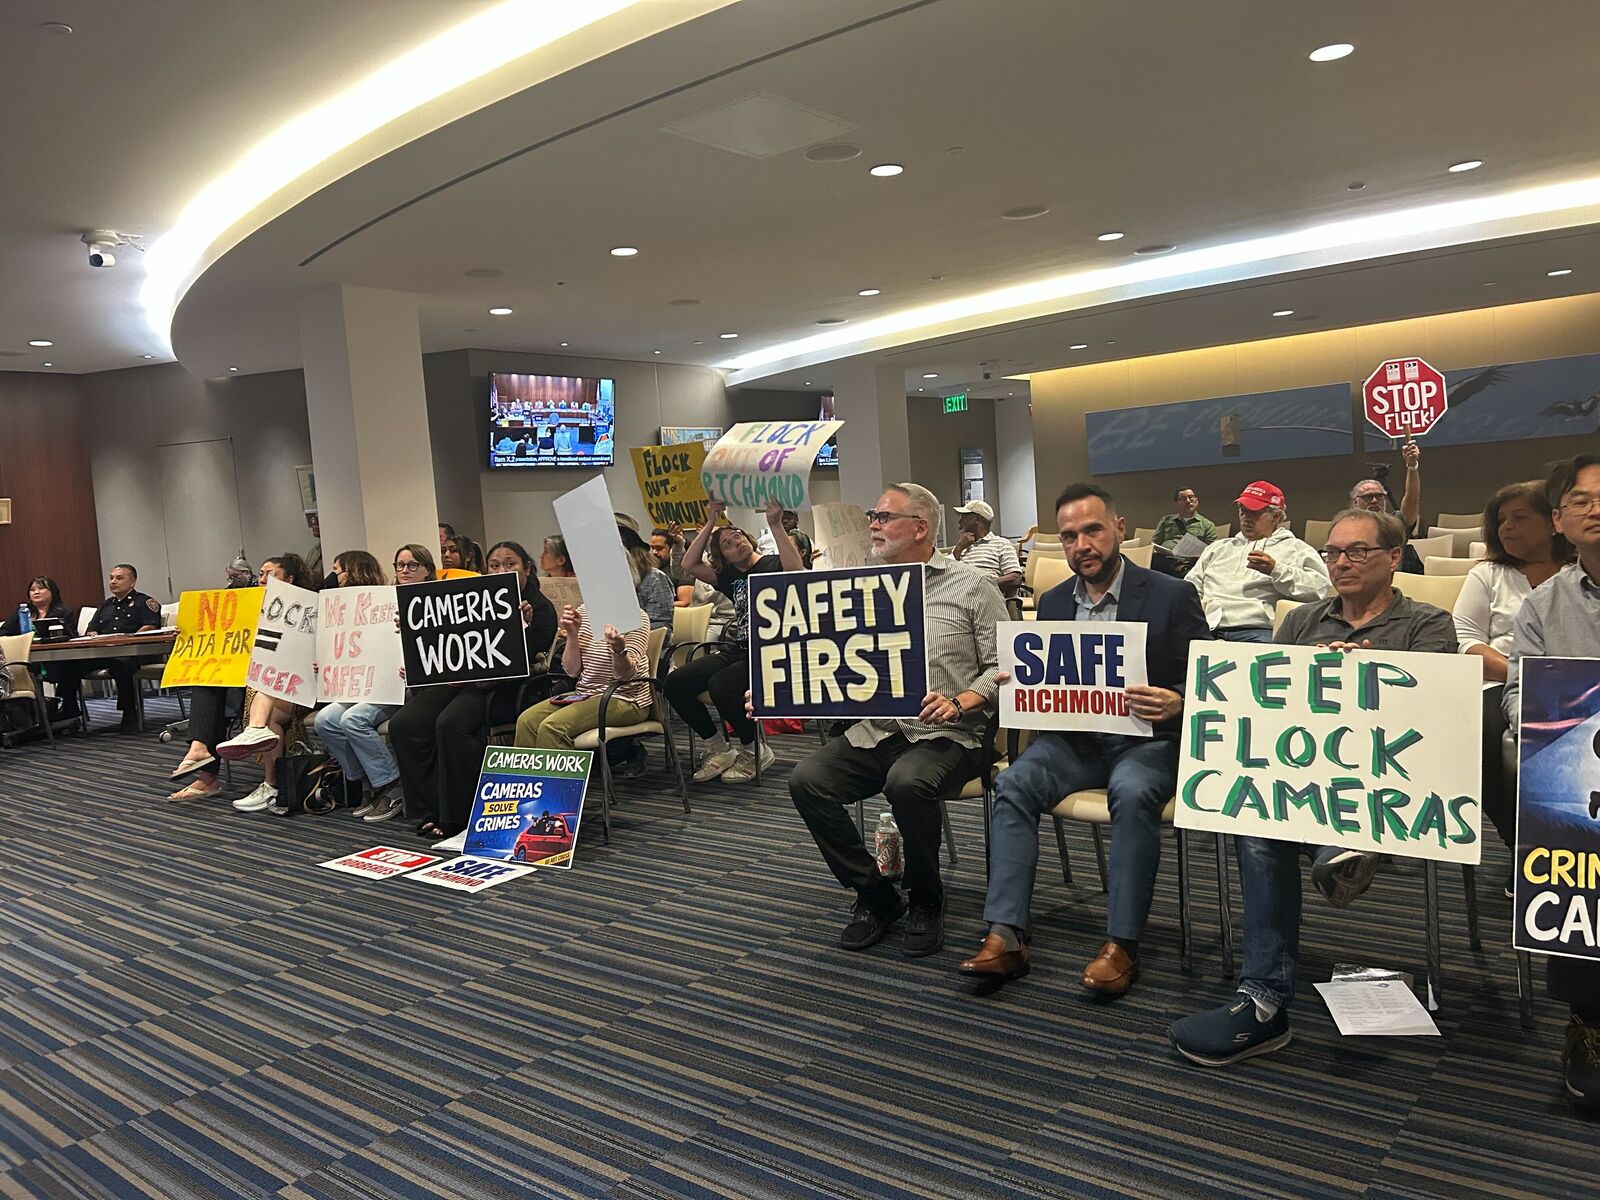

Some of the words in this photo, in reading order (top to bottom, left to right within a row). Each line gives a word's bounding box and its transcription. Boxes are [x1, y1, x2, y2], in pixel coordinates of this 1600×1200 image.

[946, 396, 964, 412] EXIT
[1372, 381, 1437, 414] STOP
[1384, 406, 1434, 430] FLOCK!
[740, 424, 825, 445] FLOCK
[643, 449, 692, 478] FLOCK
[711, 448, 756, 471] OUT
[759, 447, 797, 472] OF
[644, 479, 670, 498] OUT
[198, 591, 238, 632] NO
[260, 596, 318, 634] OCK
[407, 587, 512, 630] CAMERAS
[756, 571, 910, 640] SAFETY
[174, 633, 216, 658] DATA
[222, 628, 251, 655] FOR
[334, 631, 362, 660] US
[416, 628, 512, 676] WORK
[173, 658, 232, 684] ICE
[760, 631, 912, 707] FIRST
[1013, 632, 1125, 688] SAFE
[248, 660, 304, 697] NGER
[323, 665, 375, 697] SAFE!
[1195, 650, 1418, 714] KEEP
[1014, 688, 1130, 717] RICHMOND
[1190, 710, 1424, 782] FLOCK
[487, 751, 544, 770] CAMERAS
[545, 753, 586, 773] WORK
[480, 782, 543, 800] CAMERAS
[488, 803, 514, 813] SOLVE
[1181, 769, 1478, 849] CAMERAS
[475, 815, 521, 833] CRIMES
[369, 850, 422, 864] STOP
[441, 860, 517, 879] SAFE
[422, 870, 486, 887] RICHMOND
[1524, 890, 1600, 948] CA
